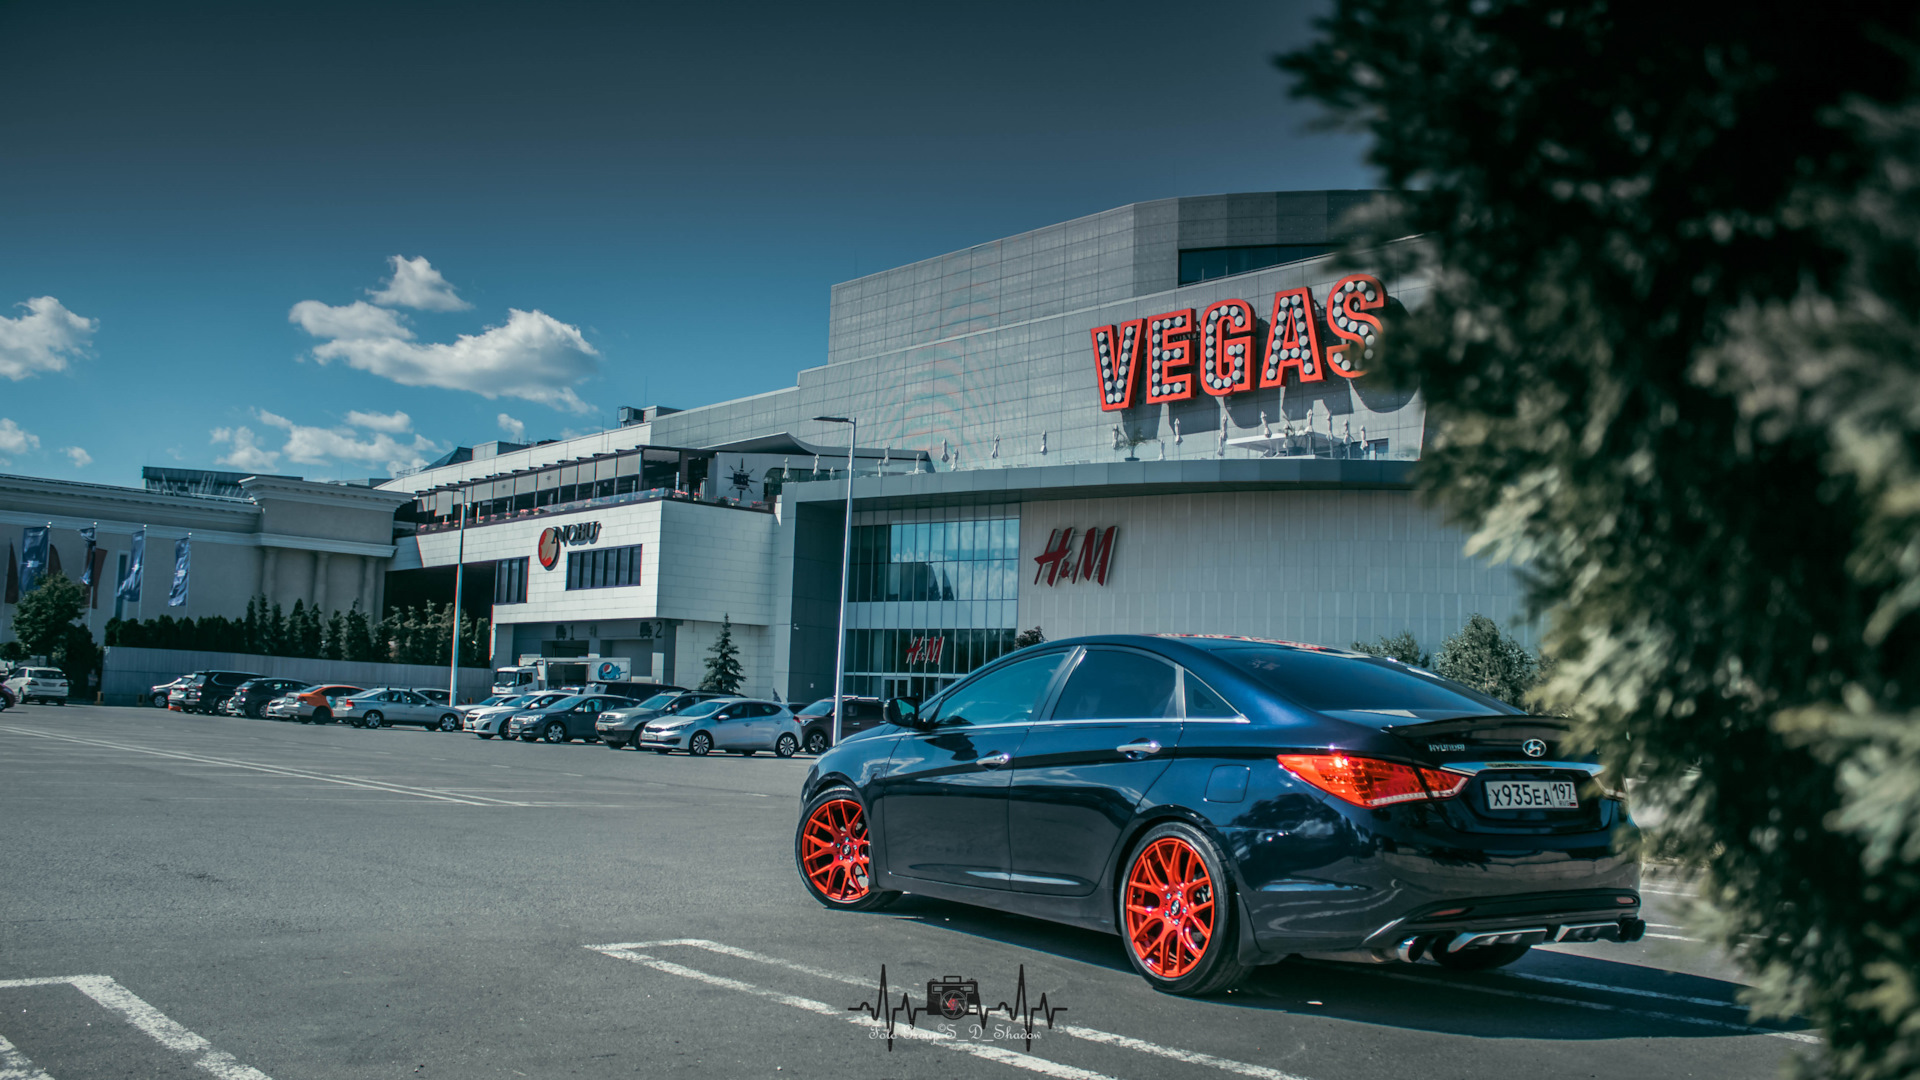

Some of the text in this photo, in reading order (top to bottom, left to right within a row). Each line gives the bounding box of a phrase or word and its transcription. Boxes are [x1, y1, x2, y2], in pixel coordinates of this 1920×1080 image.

[1090, 273, 1388, 411] VEGAS
[551, 521, 602, 547] NOBU
[1034, 526, 1118, 587] H&M
[655, 621, 663, 639] 2
[906, 636, 945, 665] H&M
